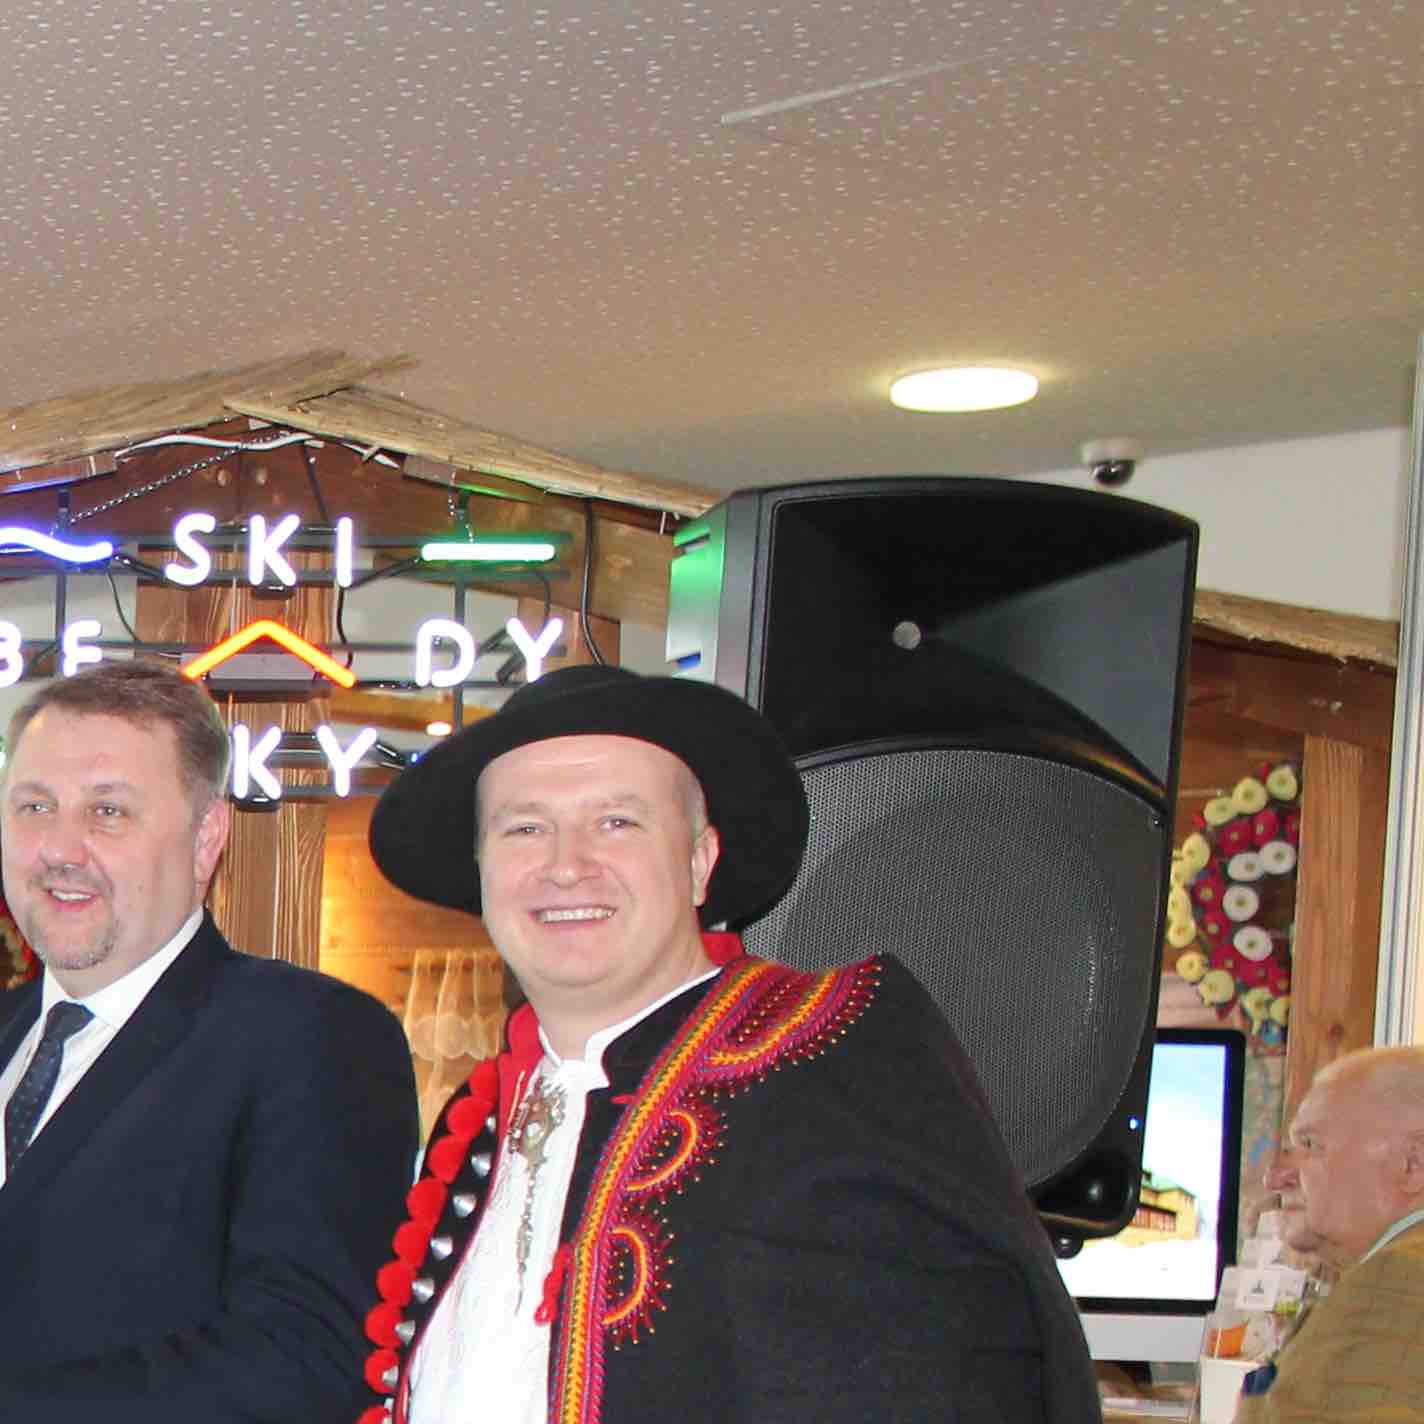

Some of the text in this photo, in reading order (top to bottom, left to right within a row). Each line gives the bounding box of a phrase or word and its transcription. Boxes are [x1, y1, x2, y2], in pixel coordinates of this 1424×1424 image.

[163, 512, 355, 588] SKI
[414, 616, 565, 689] DY
[227, 723, 378, 802] KY
